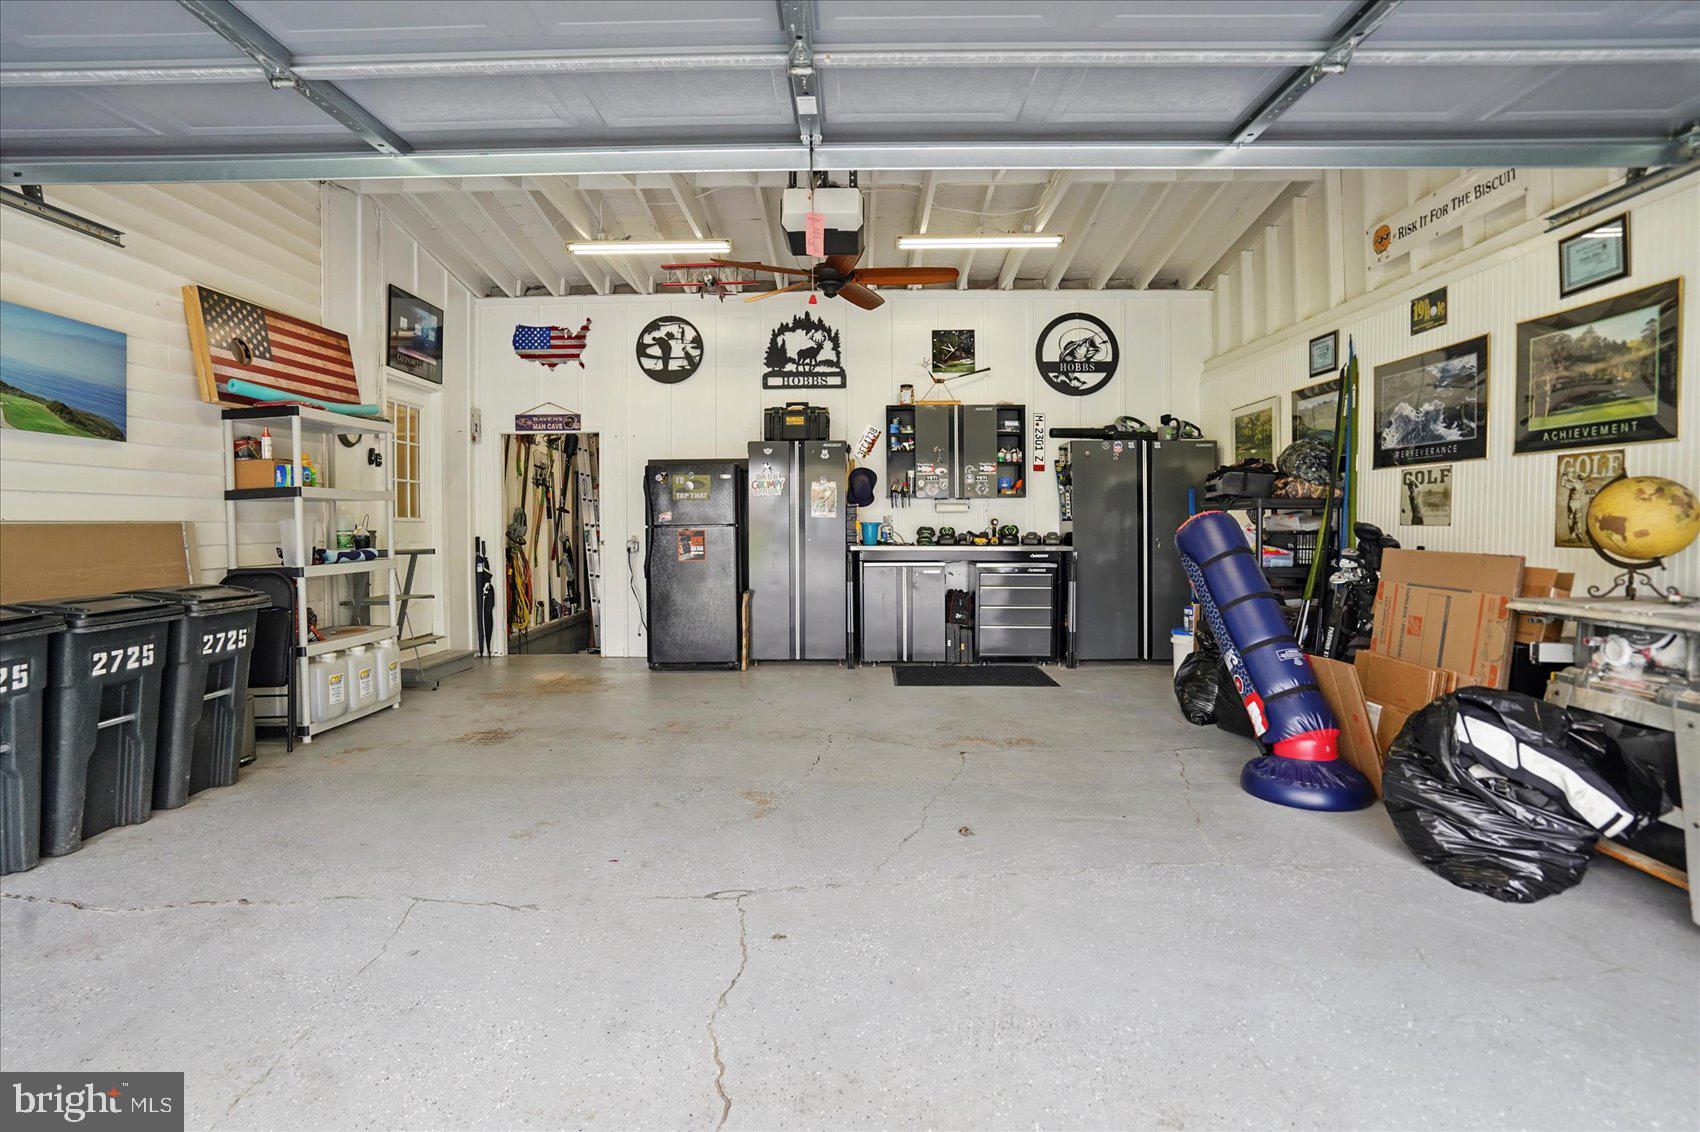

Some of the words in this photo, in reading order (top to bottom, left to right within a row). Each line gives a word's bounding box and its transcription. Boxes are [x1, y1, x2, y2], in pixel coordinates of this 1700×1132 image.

[1398, 220, 1418, 240] RISK
[1419, 214, 1428, 229] IT
[1430, 204, 1449, 224] FOR
[1450, 191, 1472, 211] THE
[1060, 363, 1095, 371] HOBBS
[782, 376, 829, 386] HOBBS
[1034, 428, 1044, 451] 2301
[1543, 421, 1639, 441] ACHIEVEMENT
[1396, 444, 1458, 459] PERSEVERANCE
[1560, 454, 1621, 478] GOLF
[1403, 469, 1451, 487] GOLF
[202, 628, 248, 655] 2725
[91, 643, 154, 677] 2725
